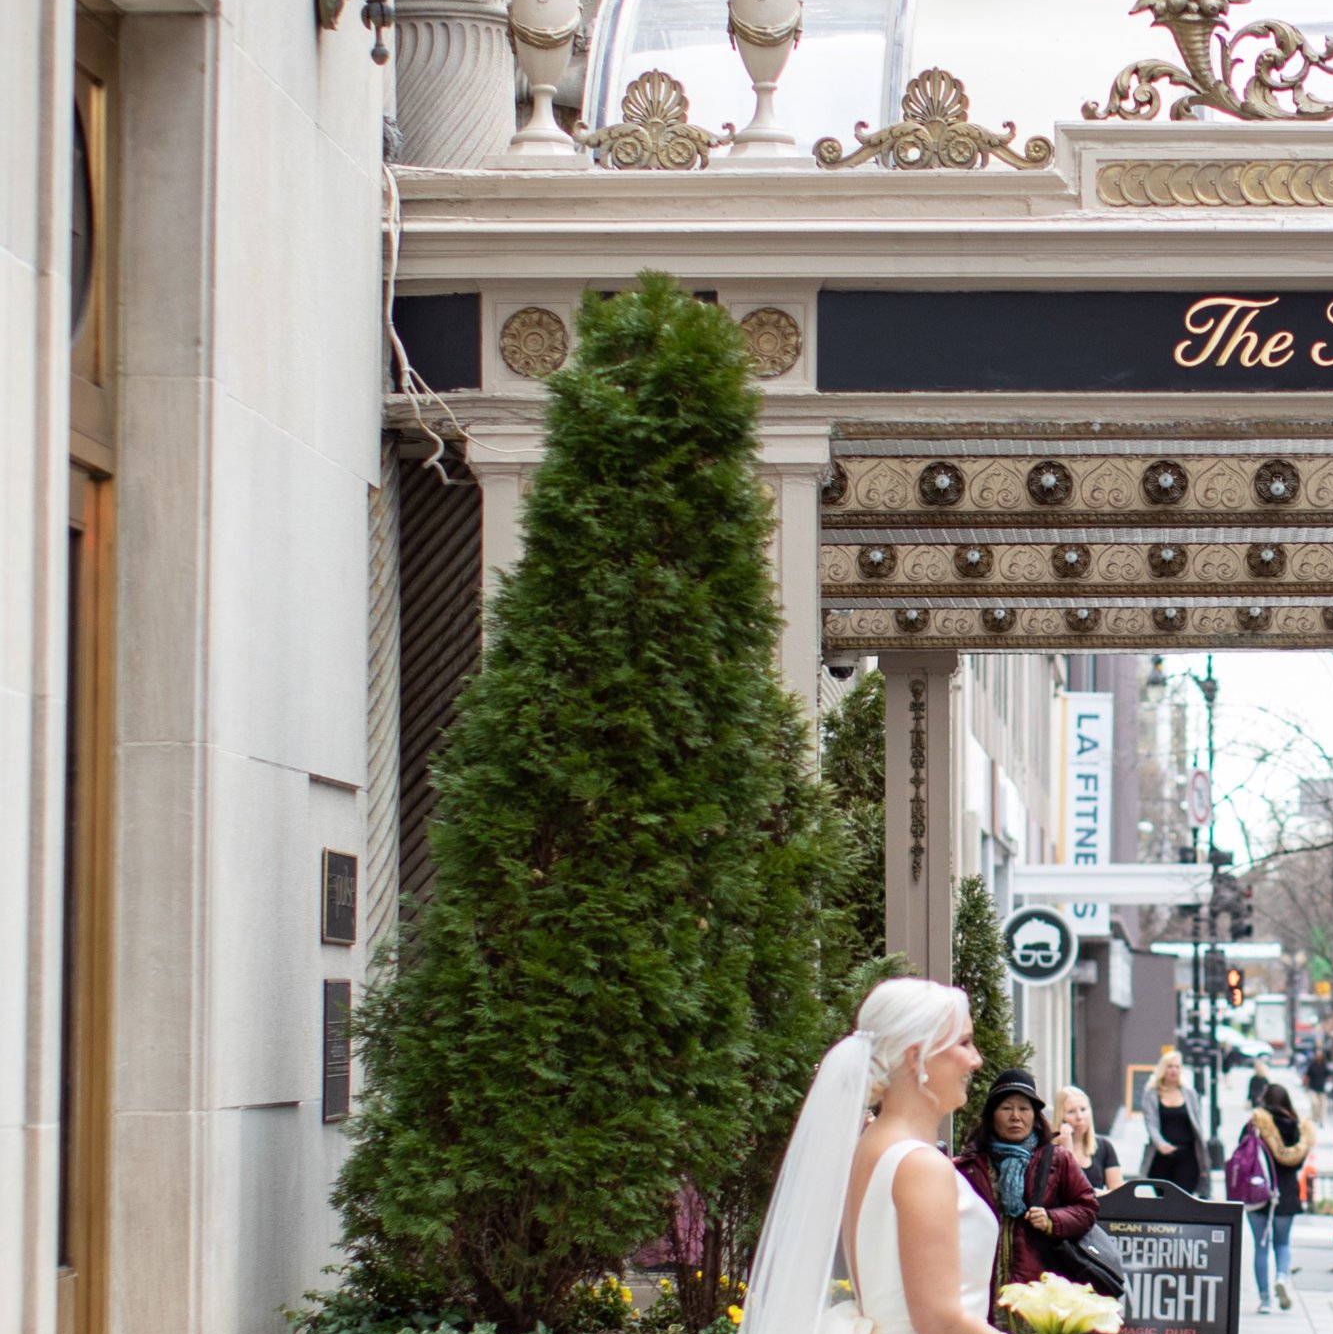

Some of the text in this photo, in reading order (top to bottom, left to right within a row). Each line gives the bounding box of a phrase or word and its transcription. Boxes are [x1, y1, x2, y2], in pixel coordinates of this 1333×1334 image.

[1174, 296, 1294, 367] The
[1073, 713, 1100, 919] LA FITNES
[1109, 1223, 1142, 1233] SCAN
